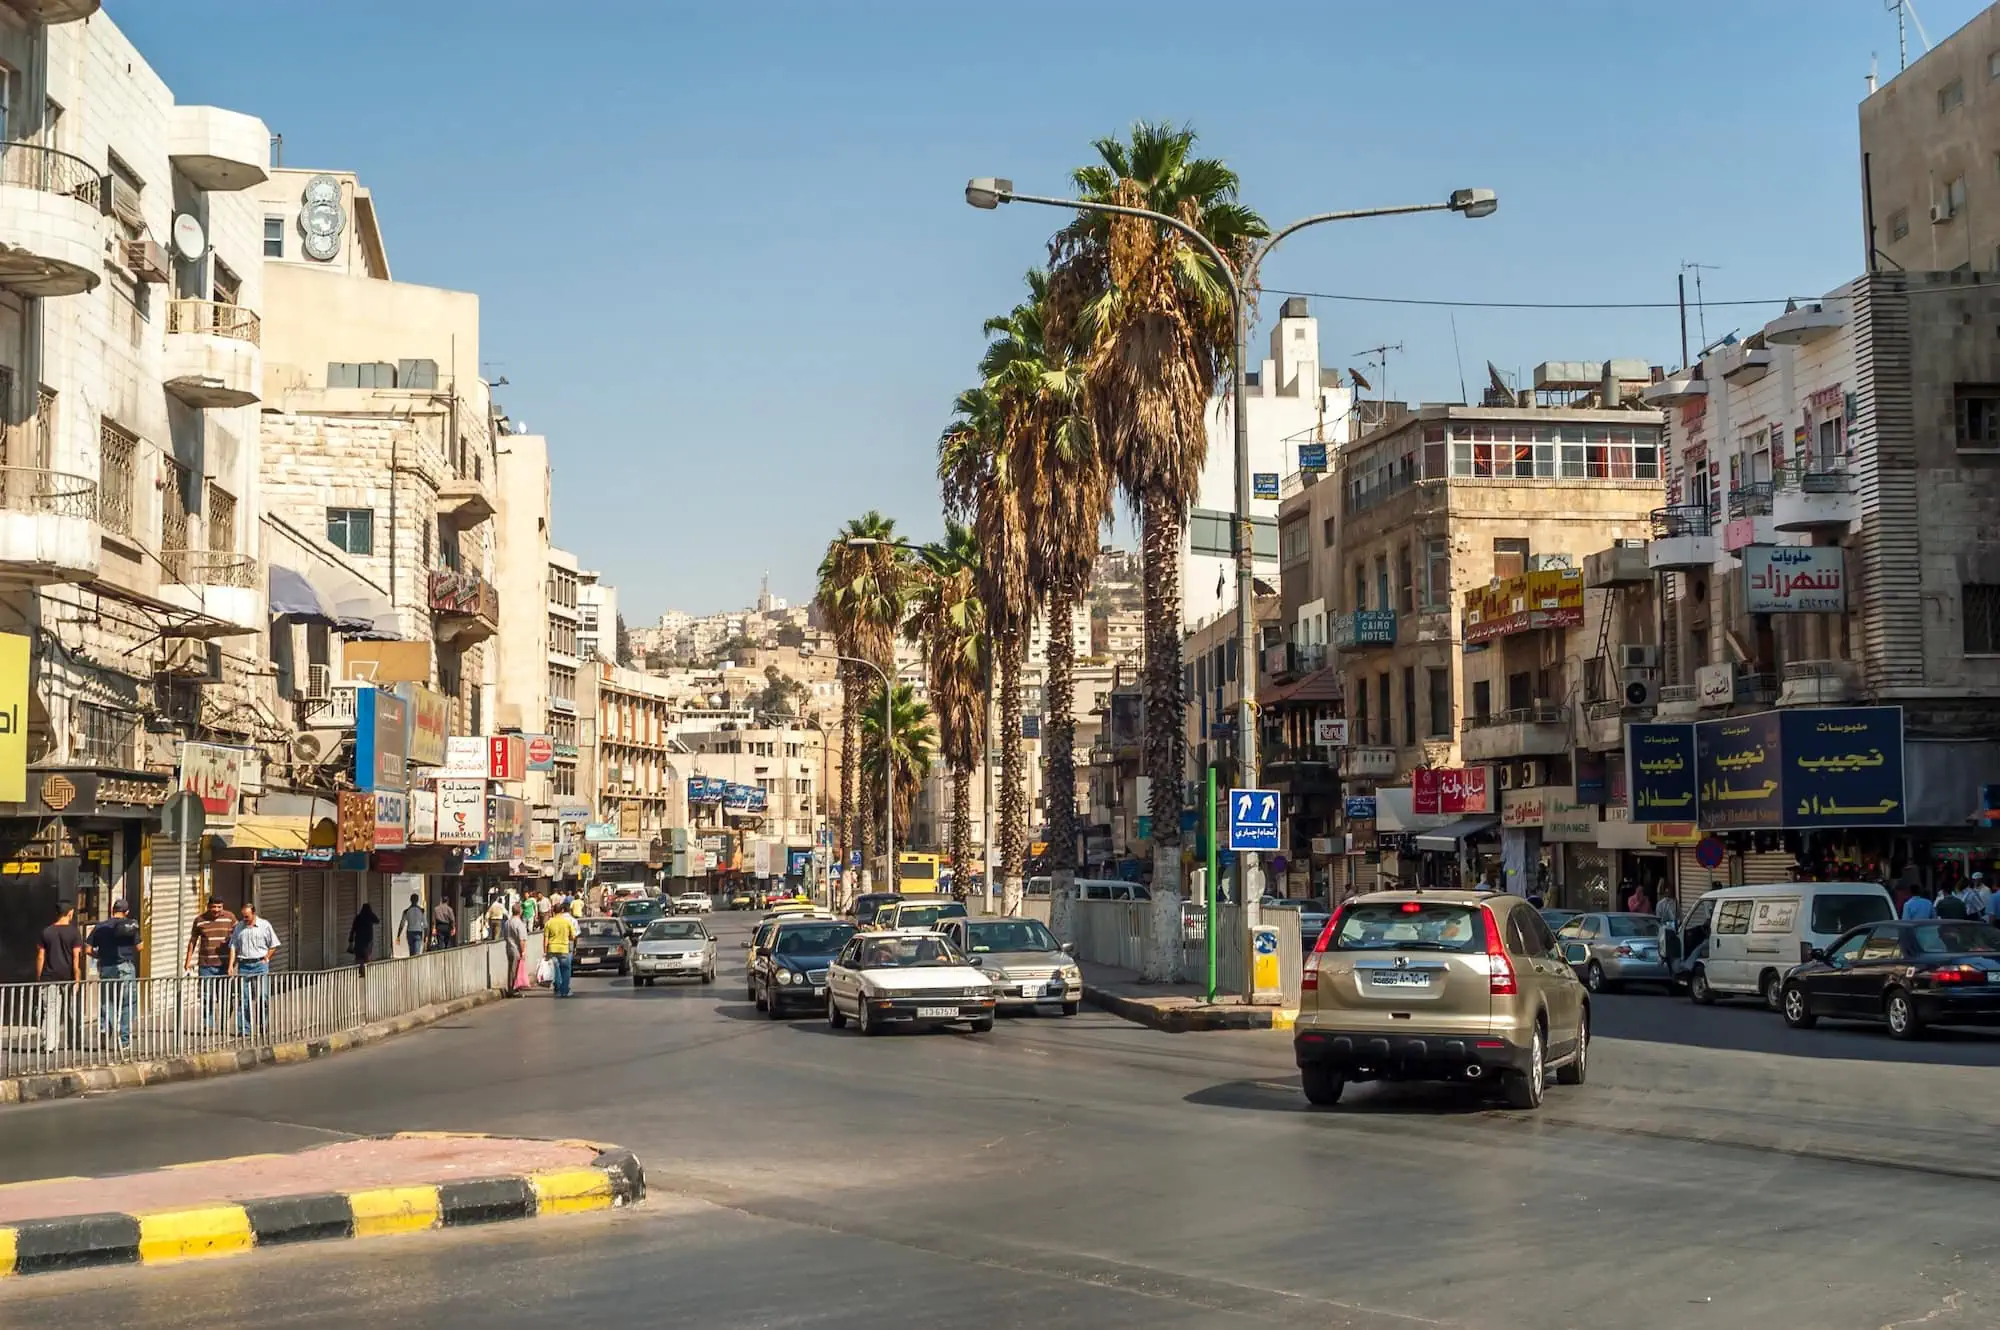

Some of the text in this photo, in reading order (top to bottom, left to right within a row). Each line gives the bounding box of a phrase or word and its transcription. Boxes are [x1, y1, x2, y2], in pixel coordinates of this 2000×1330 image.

[1771, 549, 1812, 565] حلويات
[1751, 563, 1840, 597] شهرزاد
[1361, 620, 1390, 630] CAIRO
[1361, 631, 1391, 641] HOTEL
[1721, 724, 1750, 736] ملبوسات
[1816, 722, 1868, 734] ملبوسات
[1643, 735, 1679, 745] ملبوسات
[1639, 752, 1684, 775] نجيب
[1716, 743, 1765, 771] نجيب
[1798, 748, 1884, 772] نجيب
[441, 780, 481, 794] صيدلية
[1701, 775, 1778, 801] حداد
[1637, 786, 1693, 807] حداد
[1797, 794, 1899, 815] حداد
[377, 796, 401, 822] CASIO
[440, 831, 482, 839] PHARMACY
